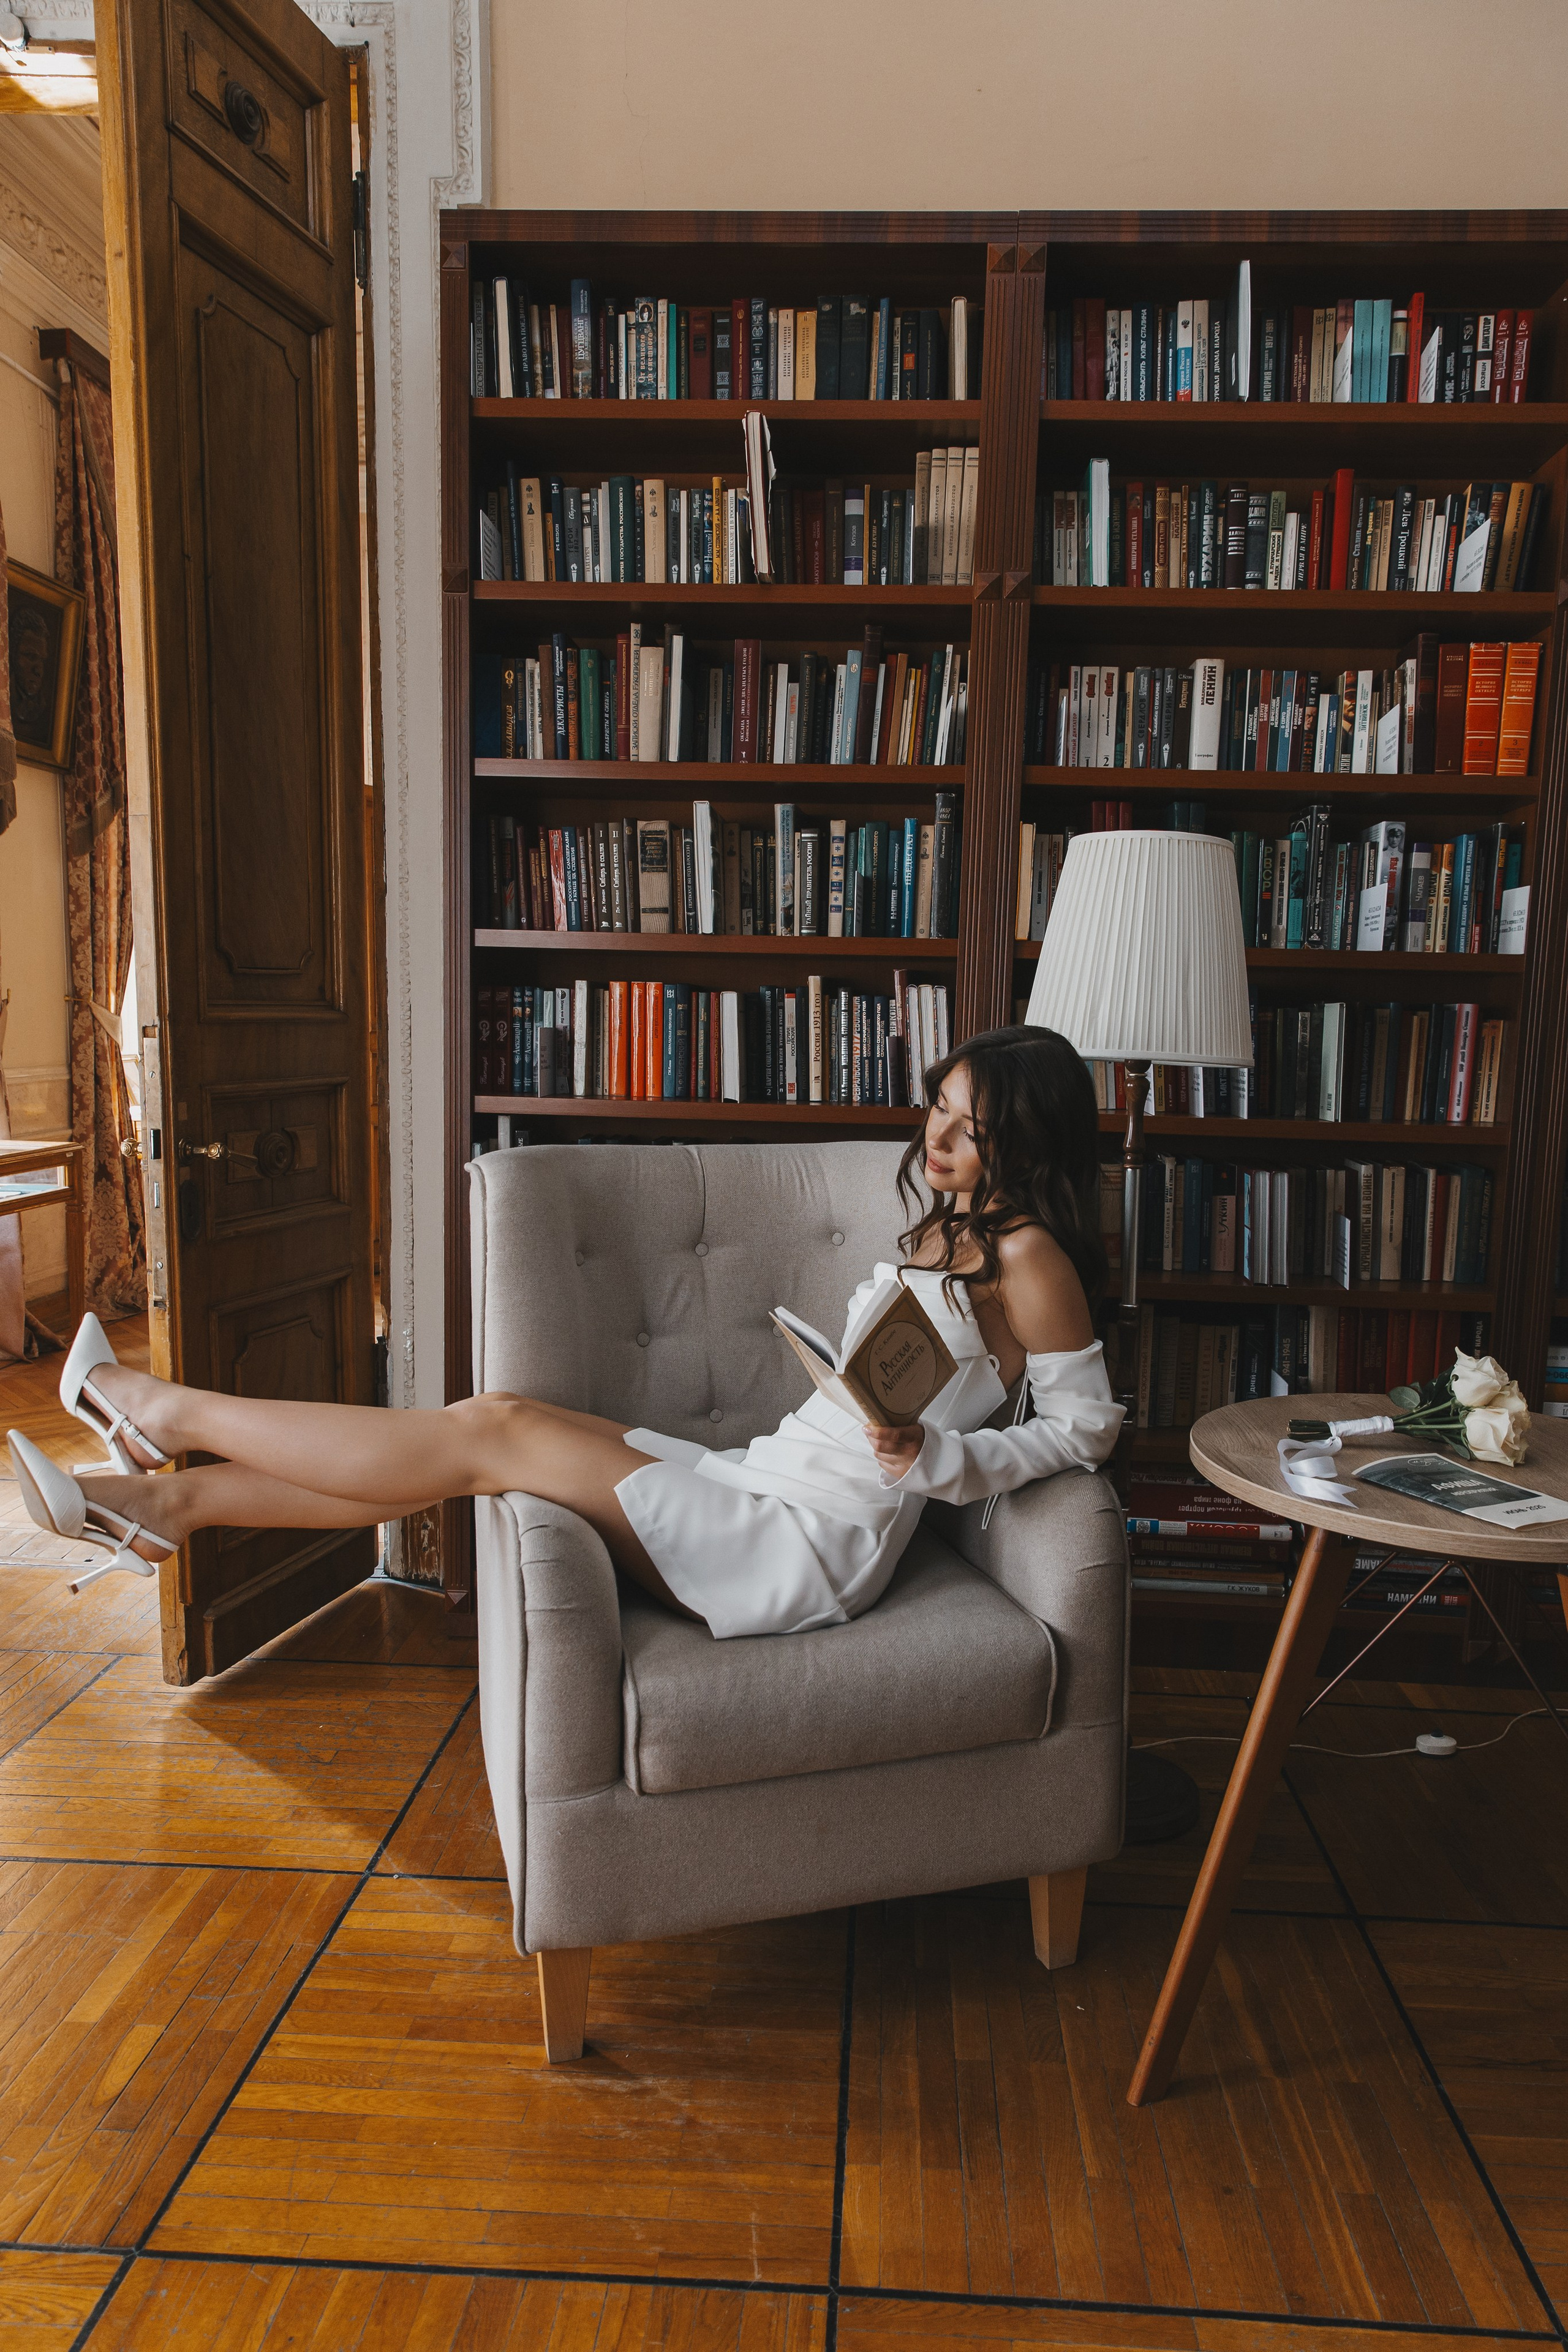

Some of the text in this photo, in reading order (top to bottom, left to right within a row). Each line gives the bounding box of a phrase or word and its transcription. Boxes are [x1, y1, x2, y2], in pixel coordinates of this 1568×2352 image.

[522, 337, 527, 347] НА
[1482, 317, 1491, 349] ДИКТАТОР
[638, 372, 645, 382] От
[1201, 514, 1214, 581] БУХАРИН
[1397, 509, 1411, 570] Лев Троцкий
[1179, 681, 1188, 708] Бухарин
[1206, 666, 1216, 705] ЛЕНИН
[557, 685, 565, 735] ДЕКАБРИСТЫ
[1360, 704, 1368, 732] ЛИТВИНОВ
[1498, 839, 1507, 867] ПУСТЫНИ
[1415, 876, 1424, 901] ЧАПАЕВ
[1443, 873, 1452, 897] КОЛЧАК
[1361, 1174, 1372, 1272] ЖУРНАЛИСТЫ НА ВОЙНЕ
[1430, 1479, 1487, 1491] АФИША
